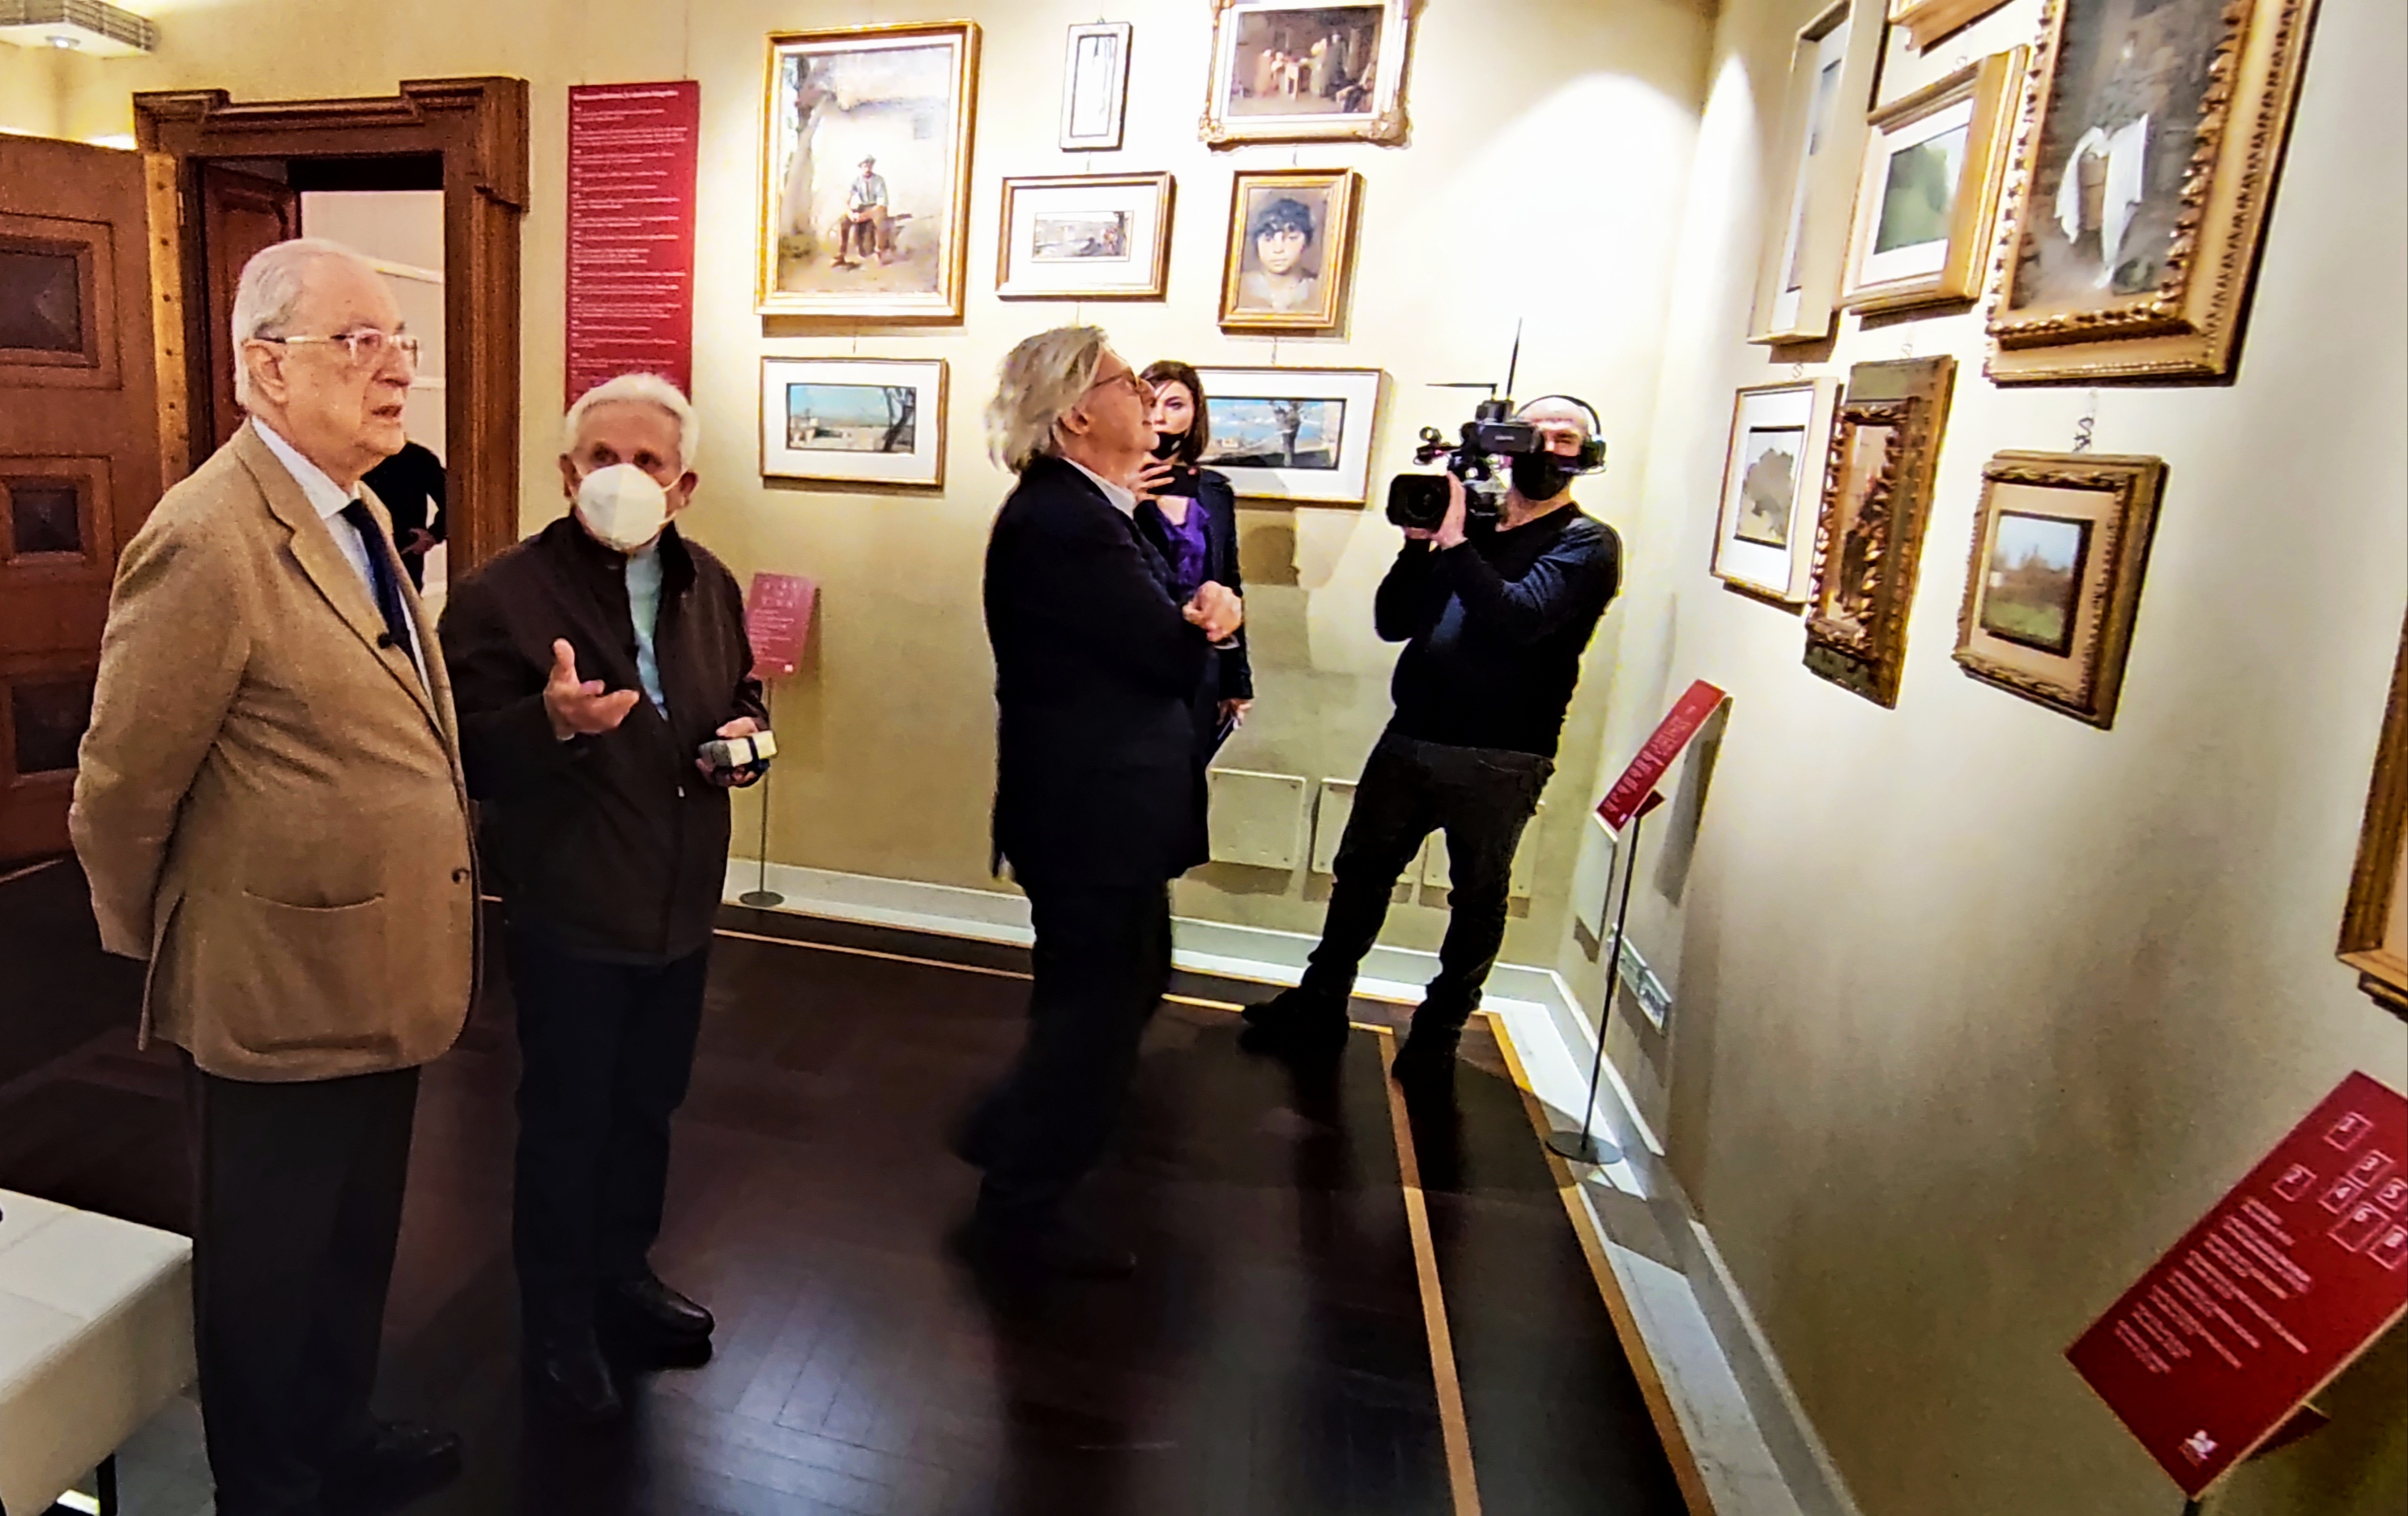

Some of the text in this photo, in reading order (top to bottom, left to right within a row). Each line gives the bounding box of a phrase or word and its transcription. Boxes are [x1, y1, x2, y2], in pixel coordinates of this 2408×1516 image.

[2358, 1156, 2379, 1171] 3
[2381, 1183, 2403, 1199] 5
[2353, 1207, 2374, 1222] 6
